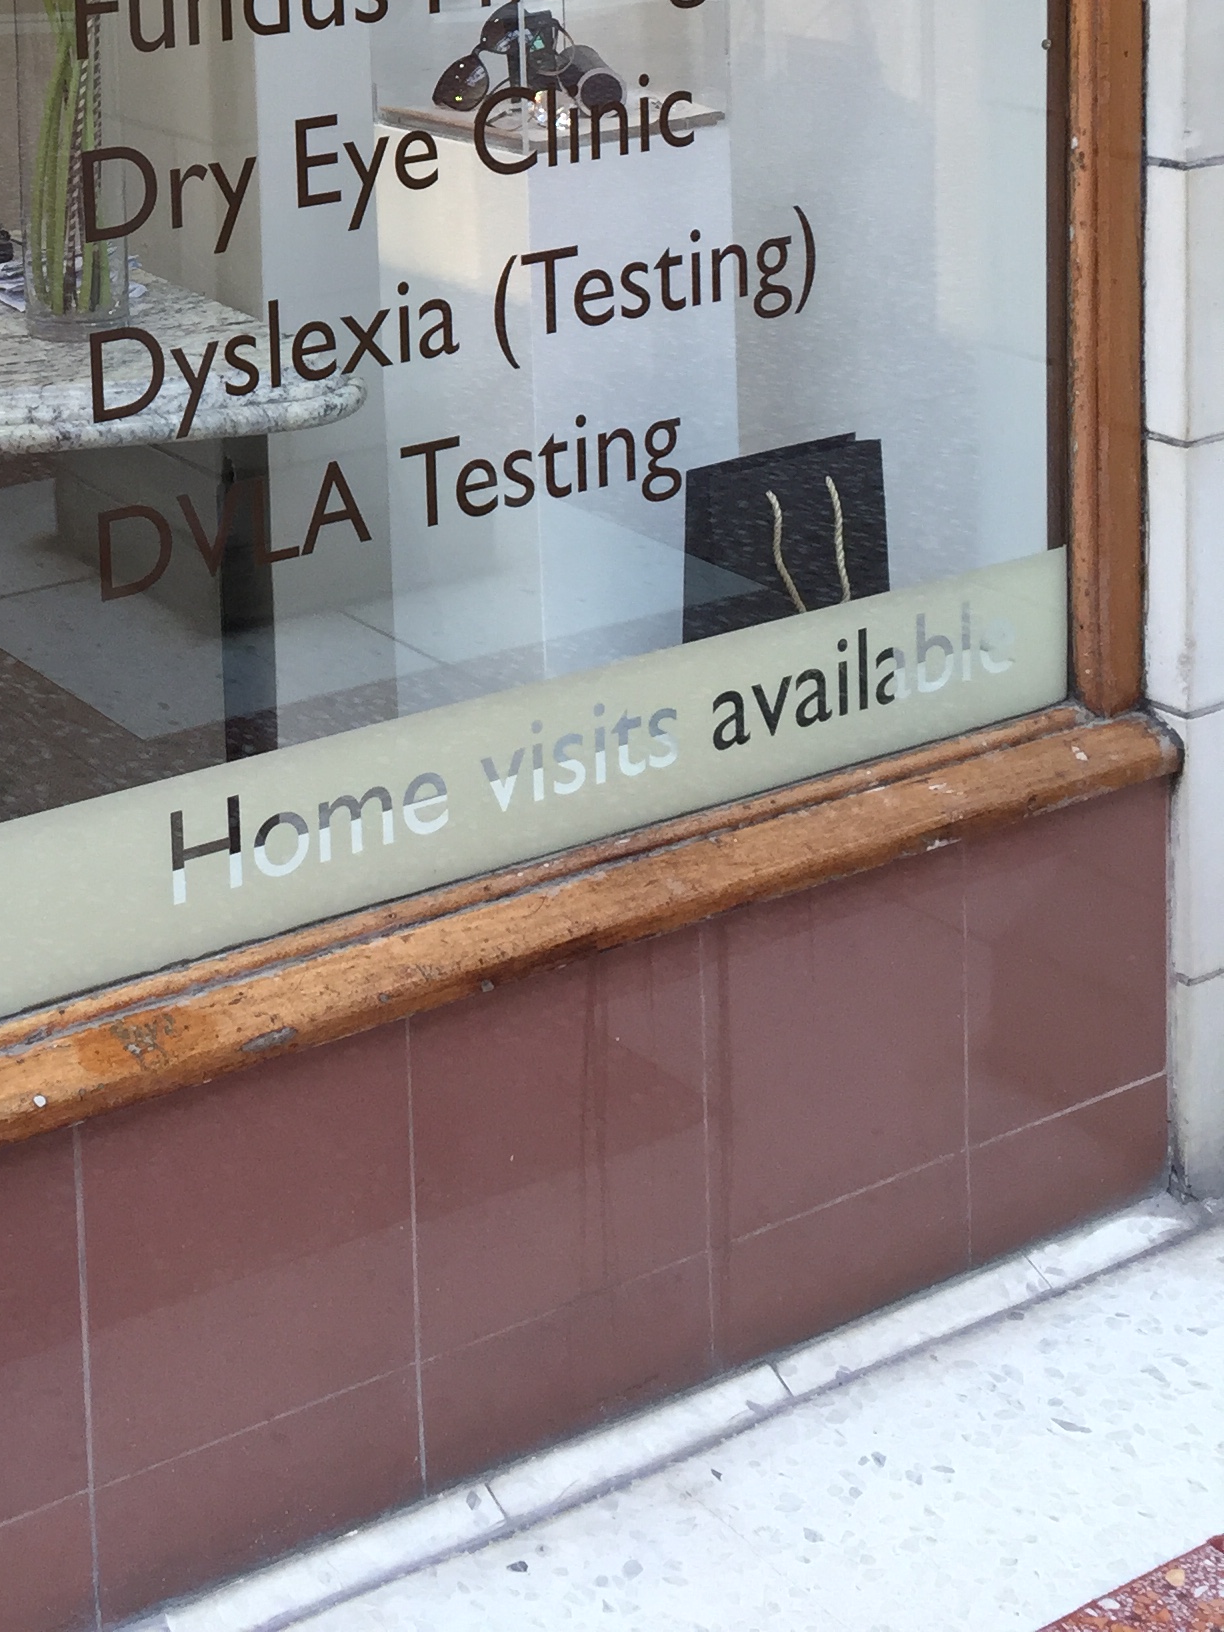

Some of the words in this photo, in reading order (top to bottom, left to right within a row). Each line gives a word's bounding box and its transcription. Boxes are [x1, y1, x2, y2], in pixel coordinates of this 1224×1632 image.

[82, 146, 257, 254] Dry
[294, 113, 439, 231] Eye
[474, 74, 695, 175] Clinic
[88, 281, 460, 439] Dyslexia
[494, 205, 818, 370] (Testing)
[98, 459, 373, 603] DVLA
[399, 414, 684, 526] Testing
[169, 770, 450, 906] Home
[480, 703, 680, 813] visits
[711, 601, 1017, 752] available
